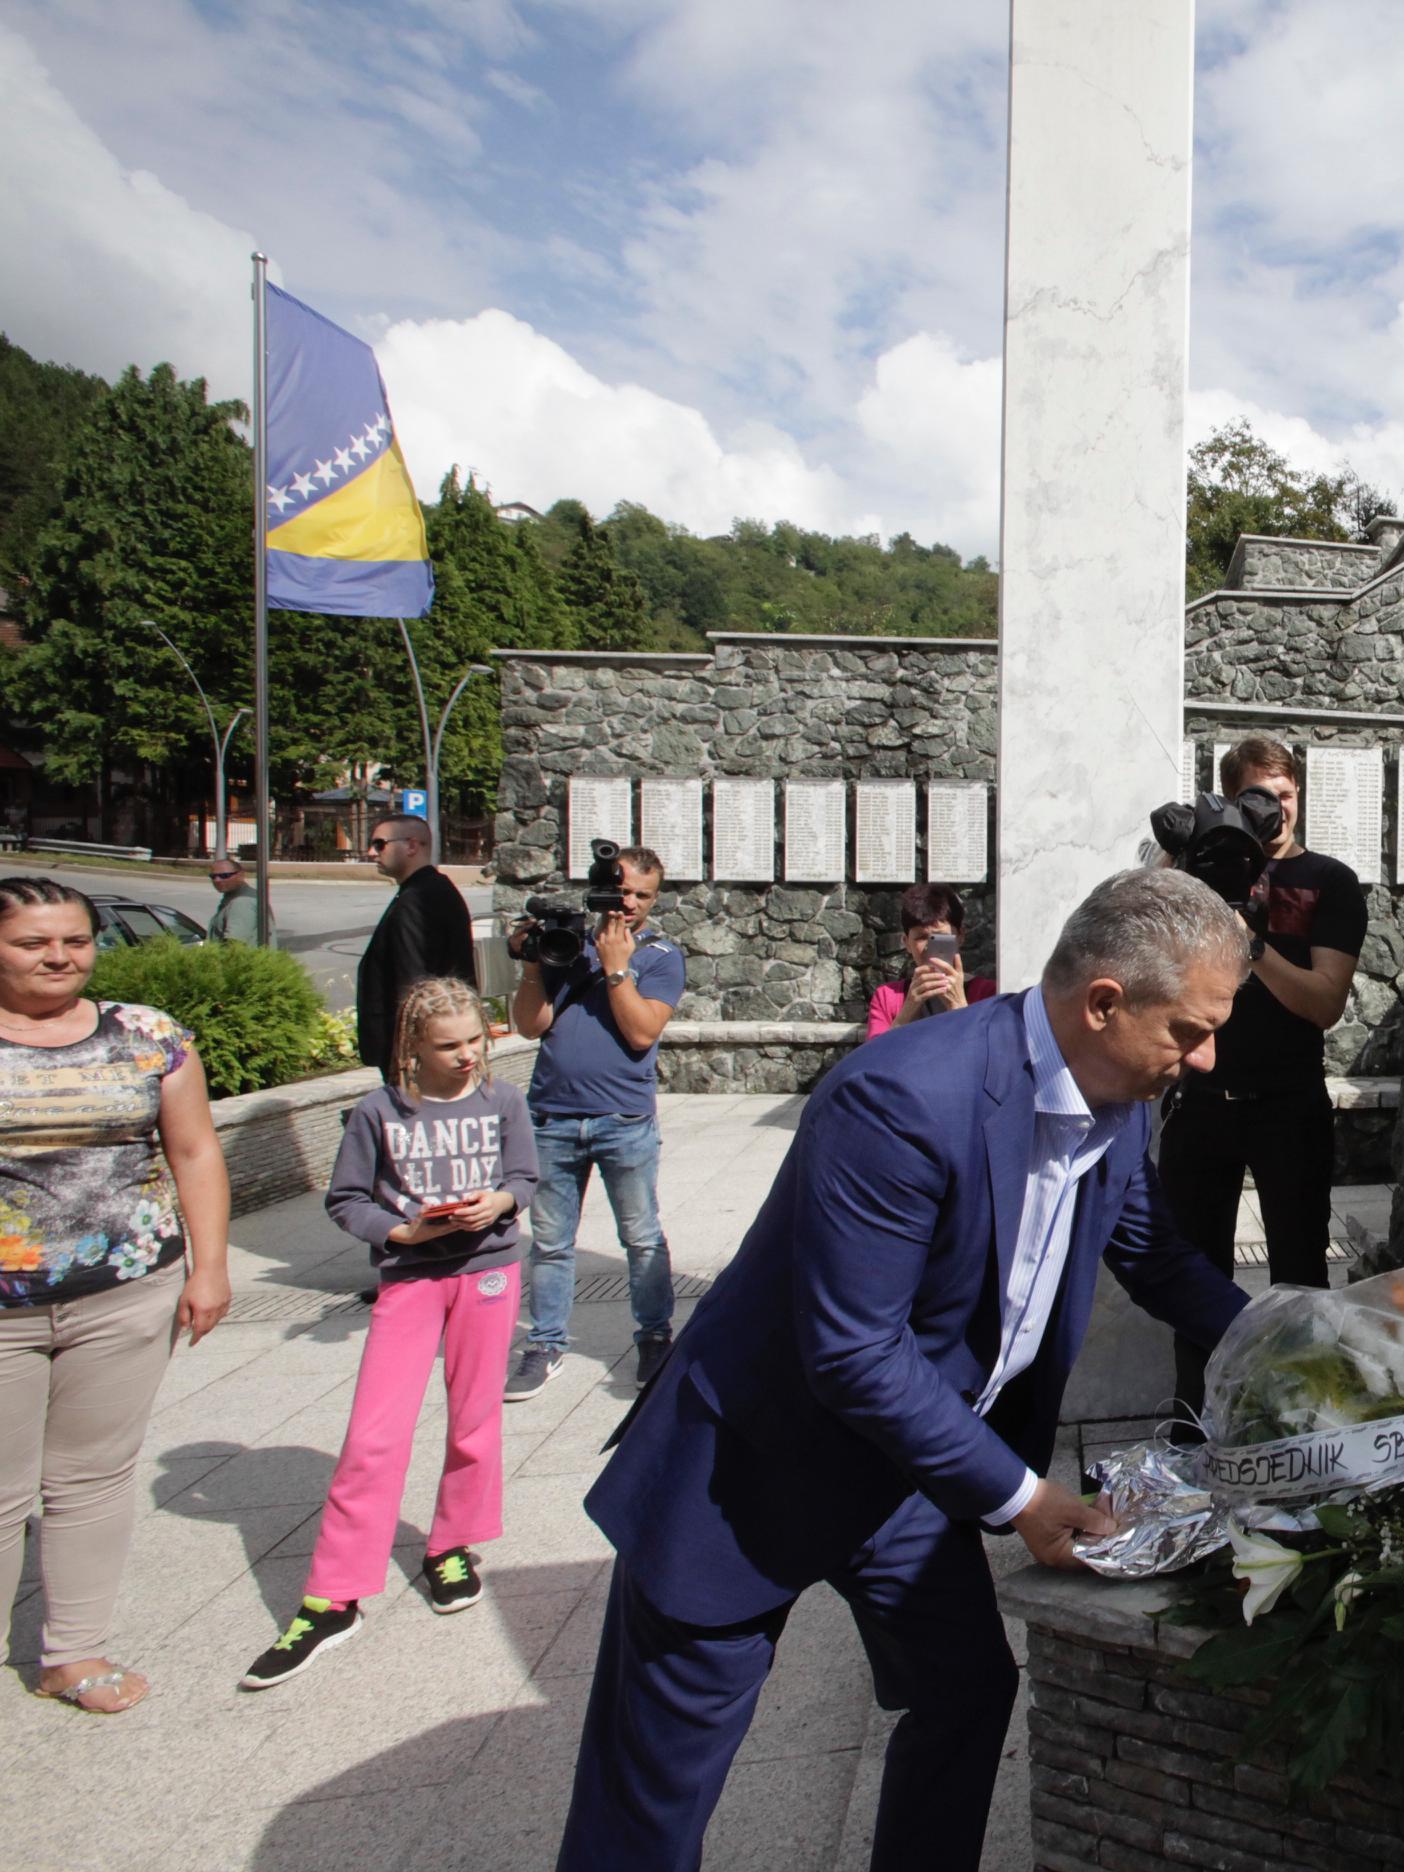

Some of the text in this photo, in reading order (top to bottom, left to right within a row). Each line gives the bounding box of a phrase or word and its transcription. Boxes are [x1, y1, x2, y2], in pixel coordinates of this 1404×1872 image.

[408, 793, 424, 810] P
[385, 1115, 500, 1160] DANCE
[450, 1156, 498, 1191] DAY
